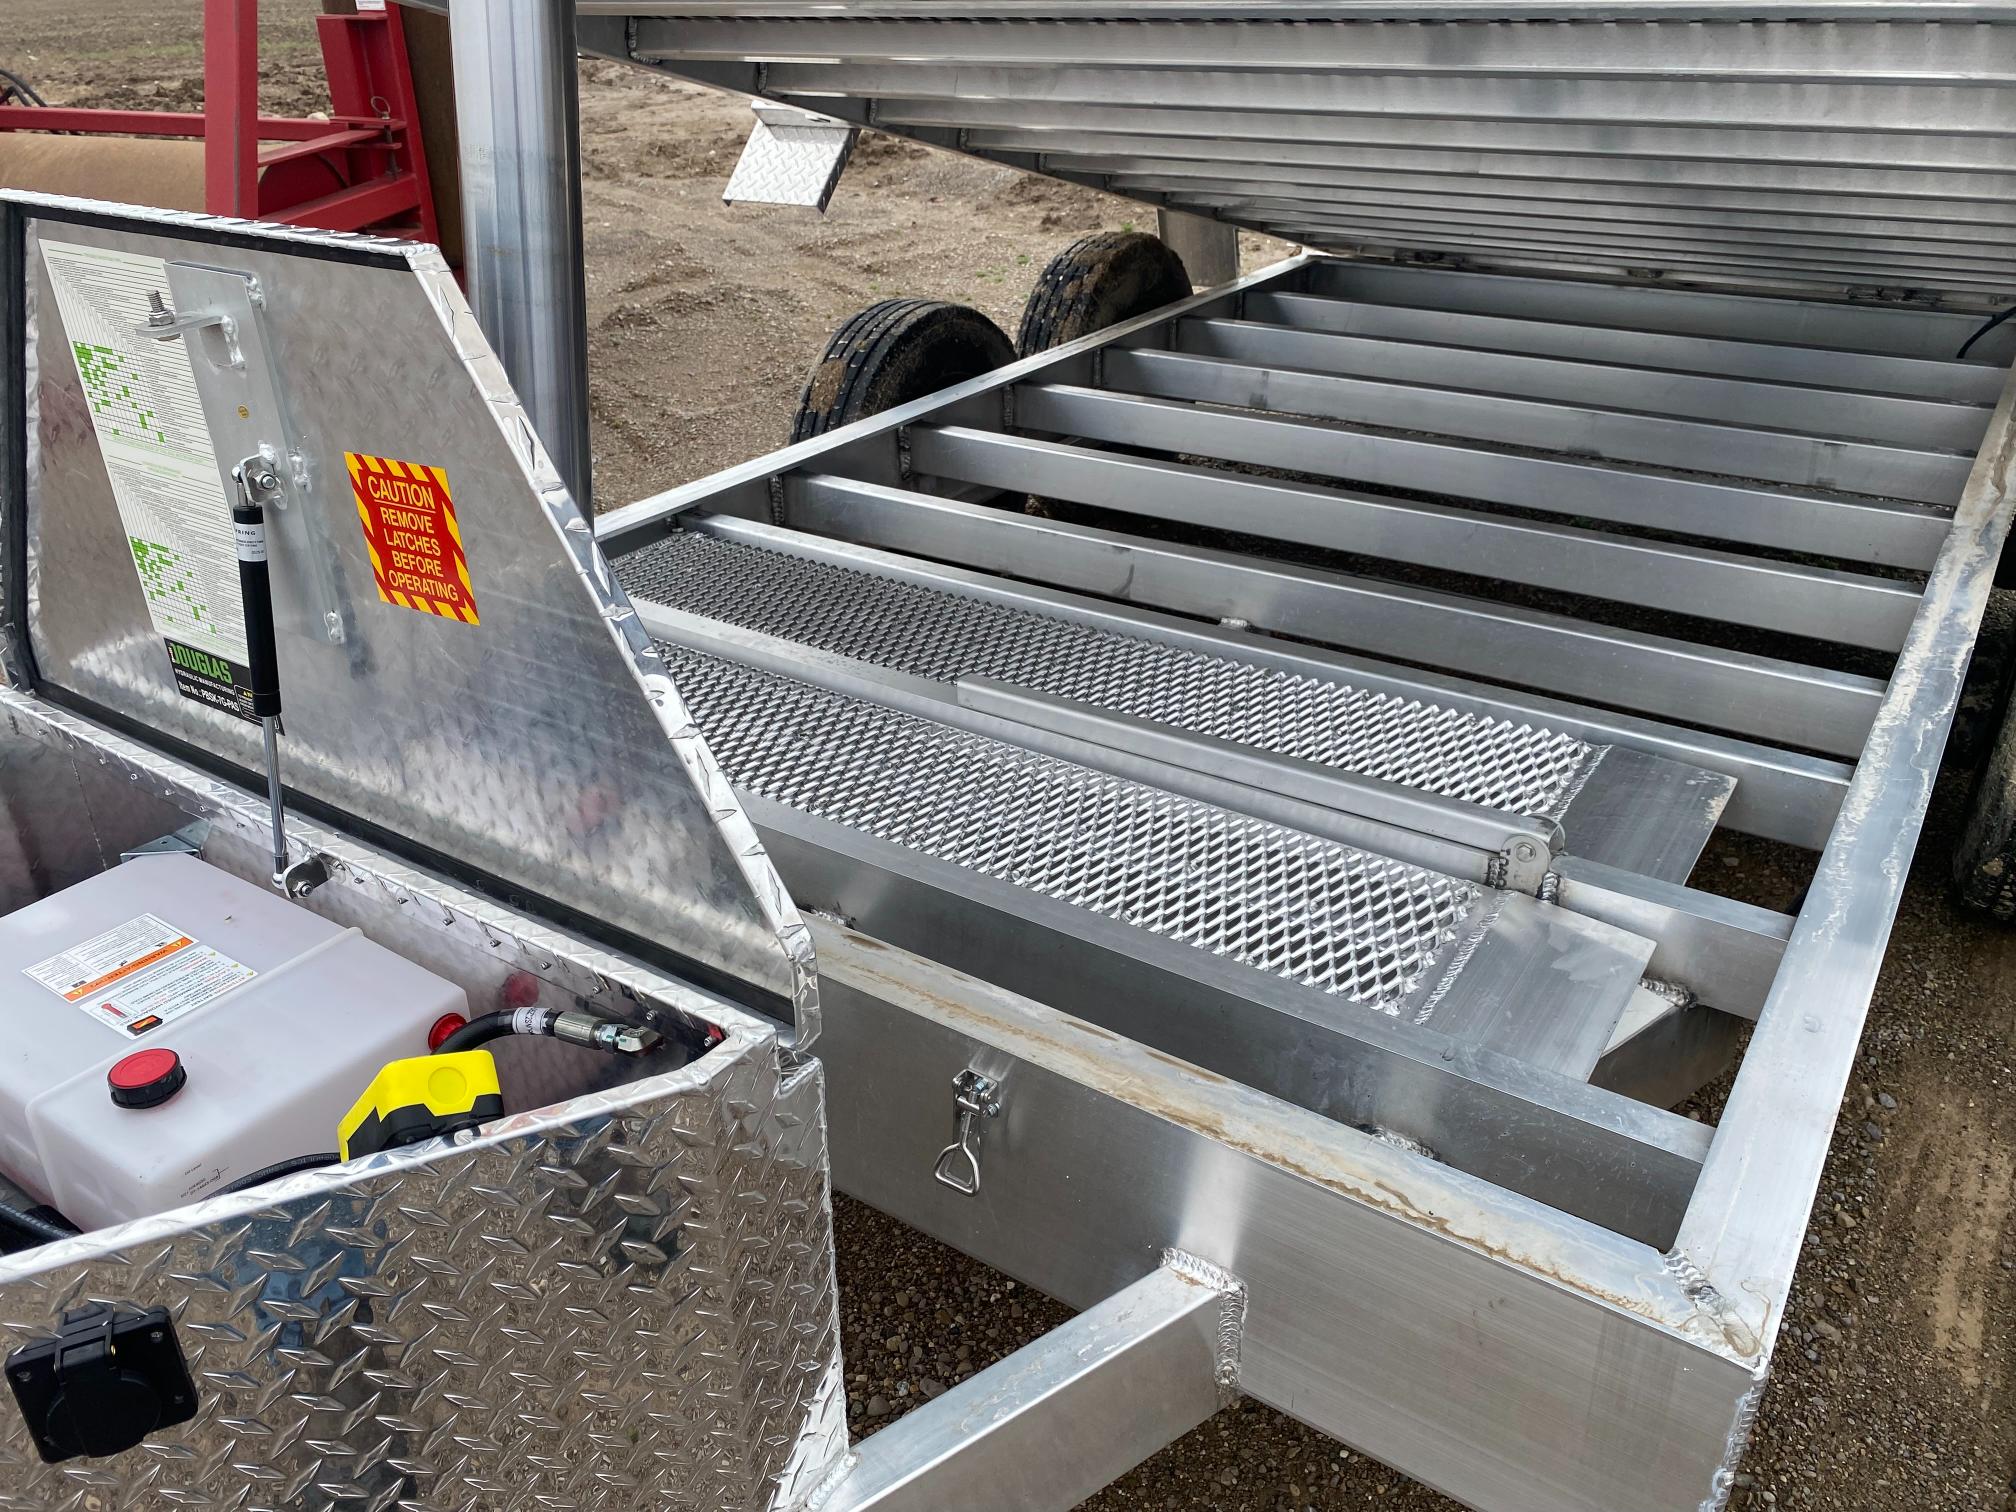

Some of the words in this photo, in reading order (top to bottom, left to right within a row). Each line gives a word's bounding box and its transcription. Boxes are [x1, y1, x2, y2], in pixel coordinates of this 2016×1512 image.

[368, 475, 435, 509] CAUTION
[380, 507, 434, 533] REMOVE
[383, 528, 441, 556] LATCHES
[392, 551, 444, 577] BEFORE
[388, 570, 458, 602] OPERATING
[170, 642, 233, 685] DOUGLAS
